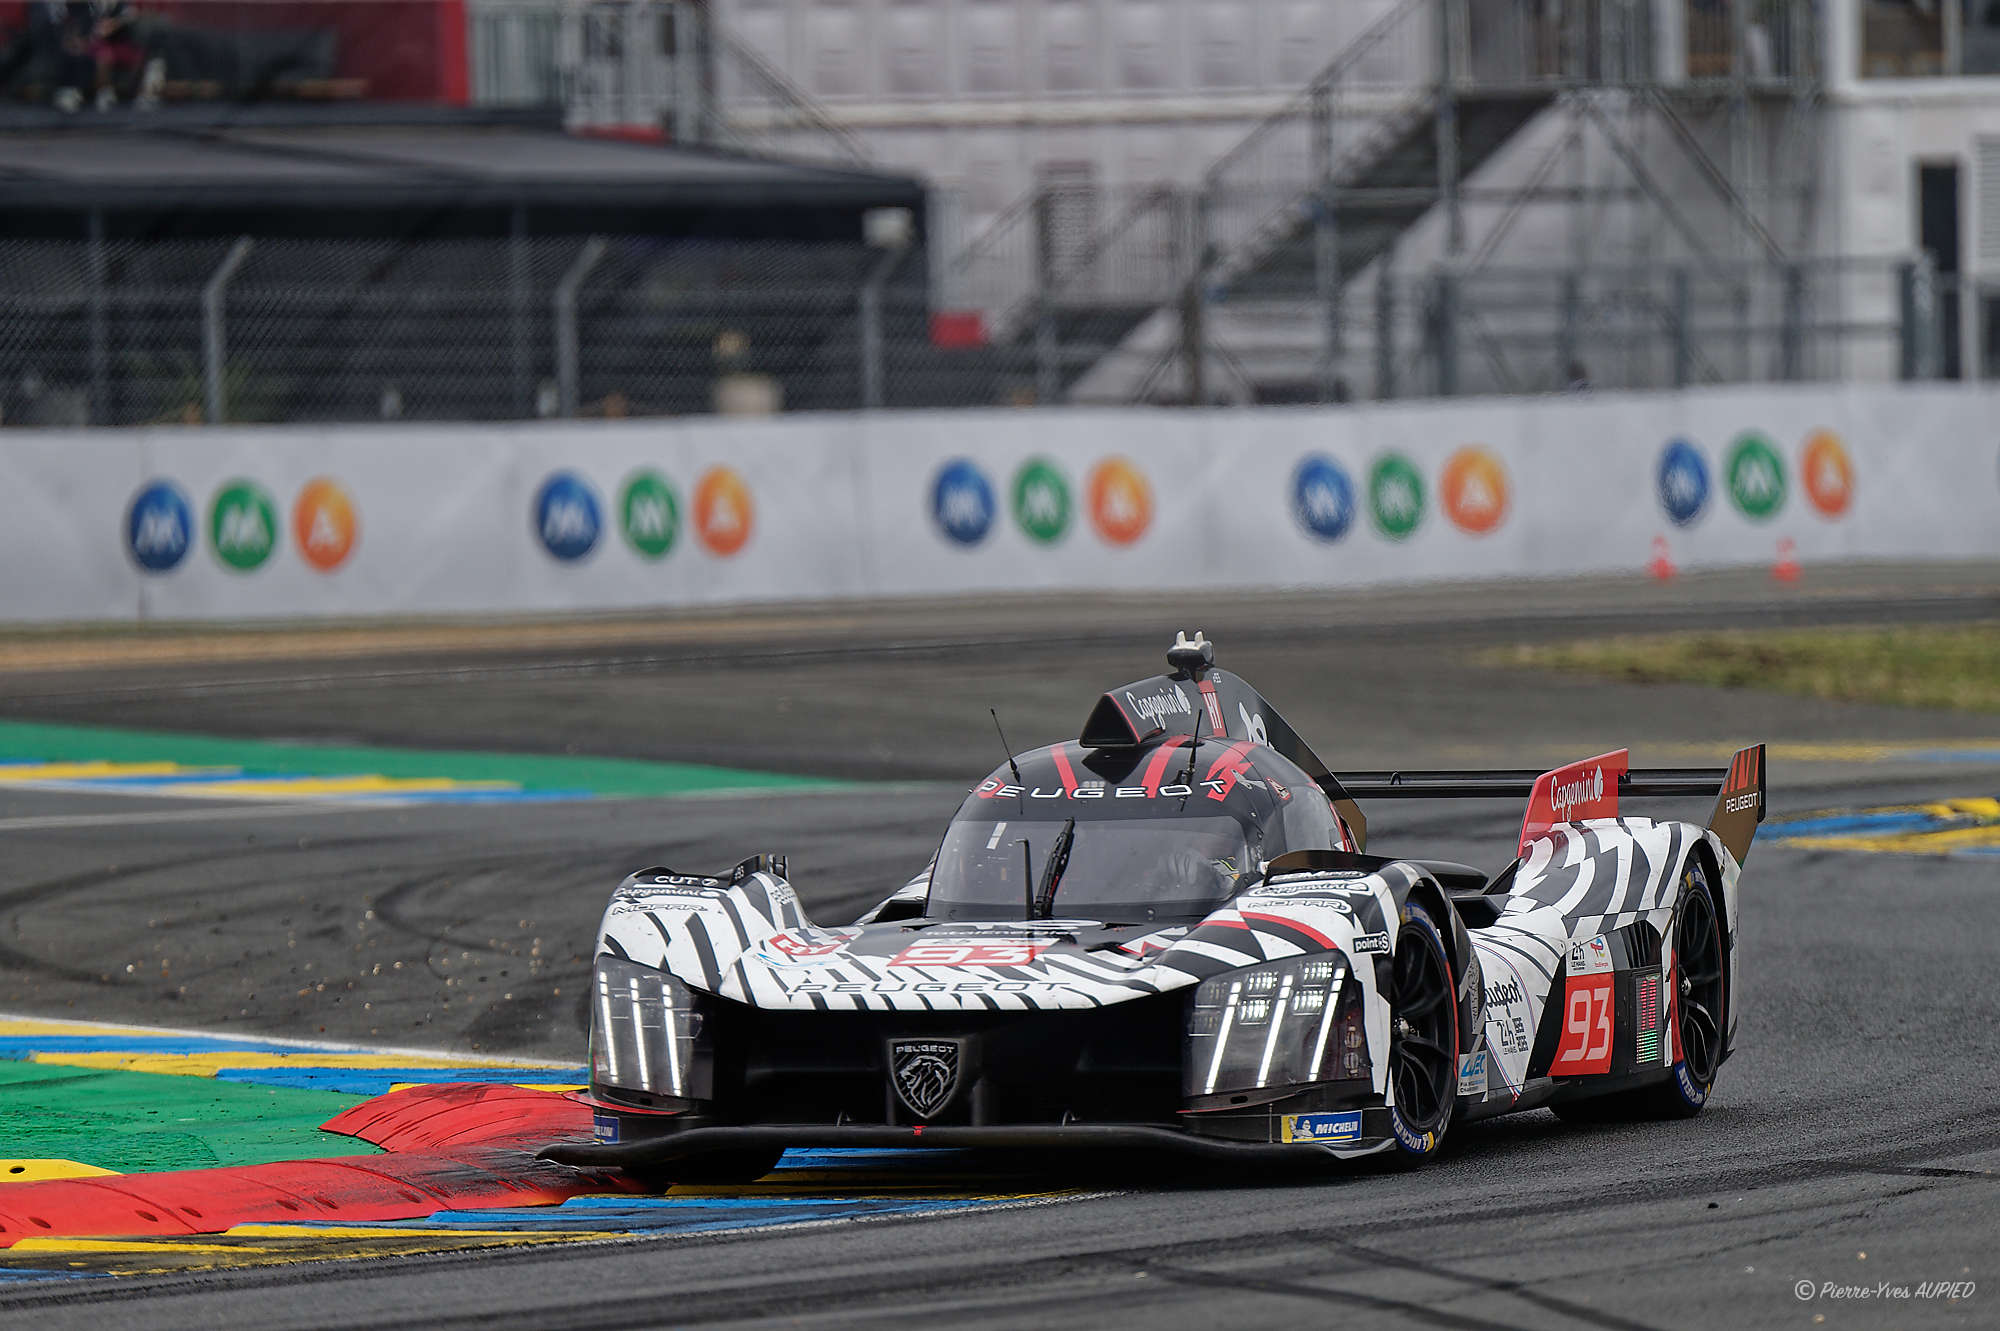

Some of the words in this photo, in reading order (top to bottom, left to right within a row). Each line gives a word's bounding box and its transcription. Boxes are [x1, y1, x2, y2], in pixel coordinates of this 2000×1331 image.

[976, 779, 1225, 799] PEUGEOT
[1551, 771, 1594, 822] Capgemini
[1726, 792, 1757, 814] PEUGEOT
[1355, 937, 1378, 951] point
[902, 946, 1034, 965] 93
[793, 981, 1072, 993] PEUGEOT
[1560, 987, 1611, 1062] 93
[896, 1045, 955, 1053] PEUGEOT
[1315, 1120, 1358, 1134] MICHELIN
